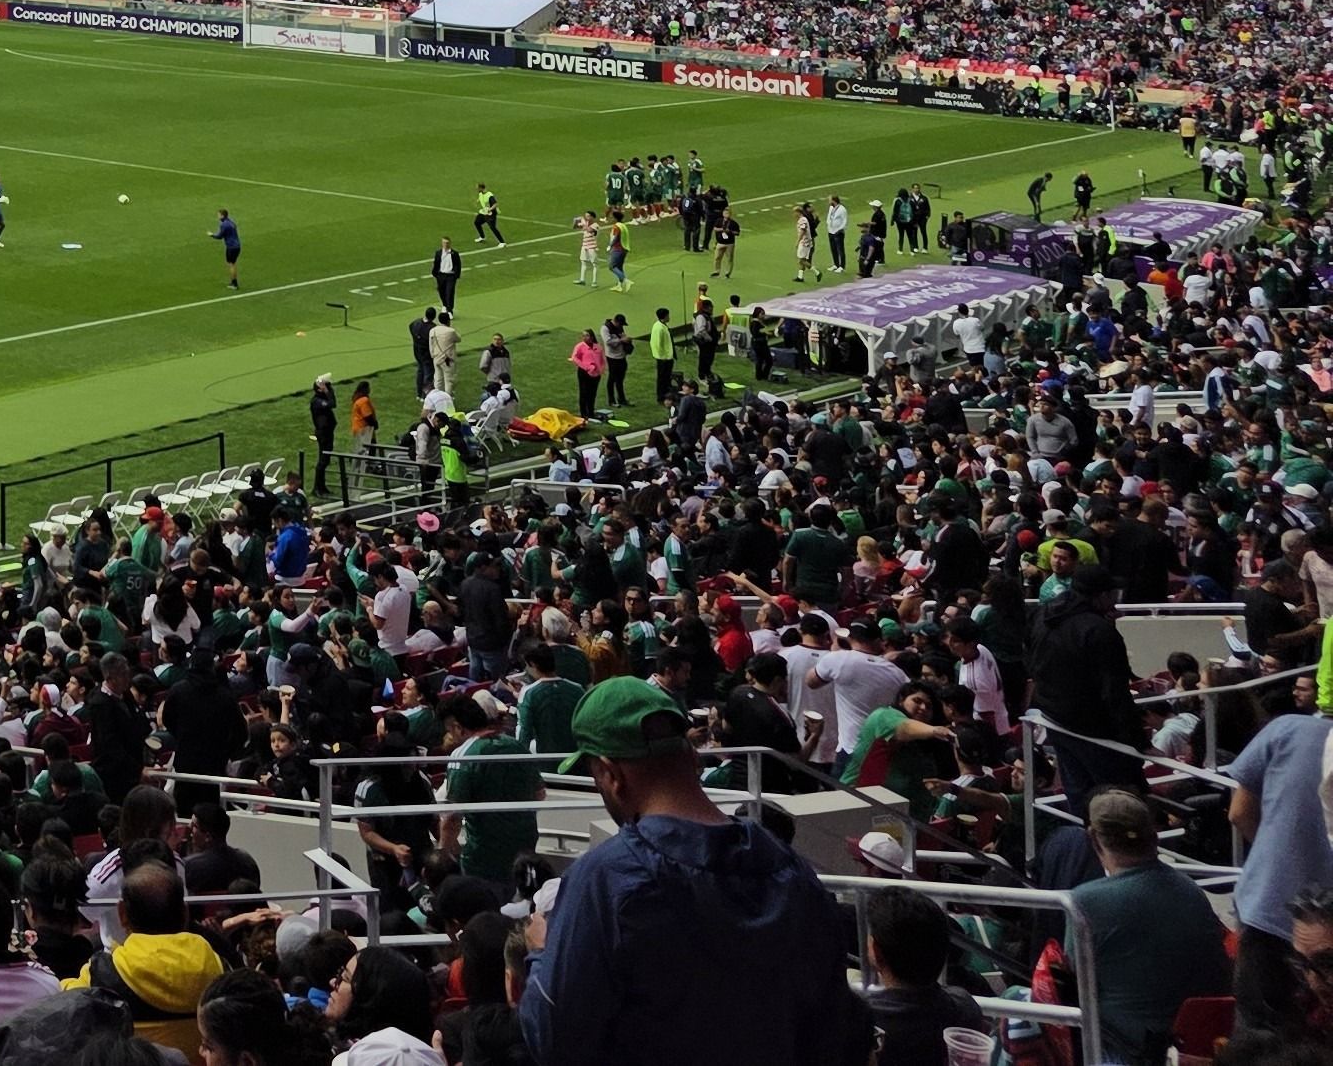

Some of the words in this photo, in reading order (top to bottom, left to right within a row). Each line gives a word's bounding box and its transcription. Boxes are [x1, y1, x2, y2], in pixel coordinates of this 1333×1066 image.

[13, 6, 71, 24] Concacaf
[74, 11, 137, 30] UNDER-20
[140, 19, 239, 39] CHAMPIONSHIP
[418, 44, 464, 58] RIYADH
[468, 49, 490, 61] AIR
[674, 64, 810, 97] Scotiabank
[852, 84, 898, 95] Concacaf
[611, 177, 622, 189] 10
[633, 175, 640, 185] 6
[126, 576, 142, 590] 50
